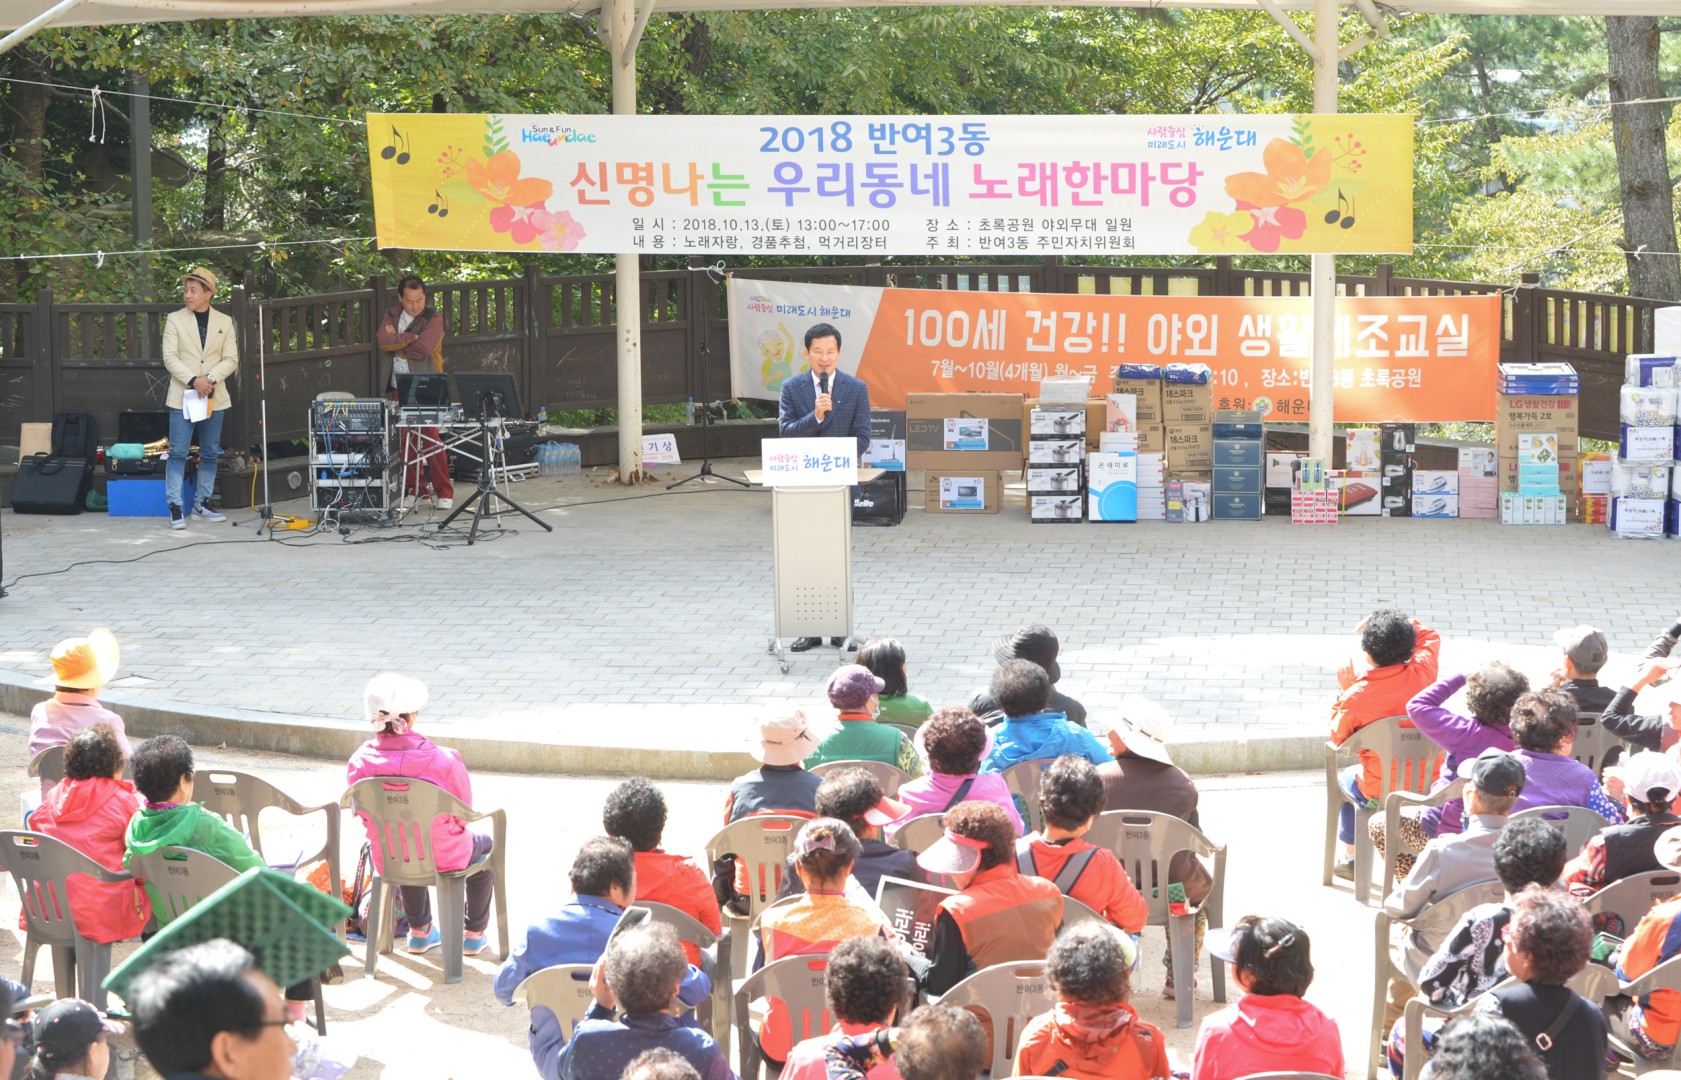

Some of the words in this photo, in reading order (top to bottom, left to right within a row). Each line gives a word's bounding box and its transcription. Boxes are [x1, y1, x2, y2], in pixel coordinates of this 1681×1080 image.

[1147, 126, 1186, 138] 사람중심
[760, 121, 853, 153] 2018
[868, 122, 991, 157] 반여3동
[1193, 126, 1257, 151] 해운대
[1147, 140, 1186, 150] 미래도시
[569, 161, 750, 208] 신명나는
[767, 161, 950, 209] 우리동네
[968, 160, 1205, 208] 노래한마당
[978, 217, 1034, 232] 초록공원
[1041, 218, 1097, 232] 야외무대
[1105, 217, 1132, 232] 일원
[683, 235, 743, 250] 노래자랑,
[751, 235, 811, 250] 경품추첨,
[818, 235, 887, 250] 먹거리장터
[979, 235, 1029, 250] 반여3동
[1036, 235, 1135, 250] 주민자치위원회
[747, 302, 773, 313] 사람중심
[776, 304, 817, 317] 미래도시
[820, 305, 851, 319] 해운대
[904, 308, 1007, 351] 100세
[1026, 310, 1126, 353] 건강!!
[1147, 313, 1218, 357] 야외
[931, 359, 1048, 382] 7월~10월(4개월)
[1054, 363, 1098, 383] 월~금
[1261, 368, 1355, 388] 장소:반3동
[1359, 369, 1422, 389] 초록공원
[1166, 389, 1193, 398] 18스파크
[1509, 400, 1523, 409] LG
[1525, 400, 1555, 409] 생활건강
[1508, 412, 1538, 421] 행복가득
[1540, 412, 1552, 420] 2호
[909, 425, 928, 433] LED
[929, 425, 939, 433] TV
[1170, 435, 1198, 444] 18스파크
[768, 453, 798, 463] 사람중심
[803, 453, 850, 472] 해운대
[769, 464, 799, 472] 미래도시
[387, 795, 409, 805] 반여3동
[764, 835, 788, 845] 반여3동
[1125, 830, 1150, 840] 반여3동
[1016, 983, 1044, 994] 반여3동
